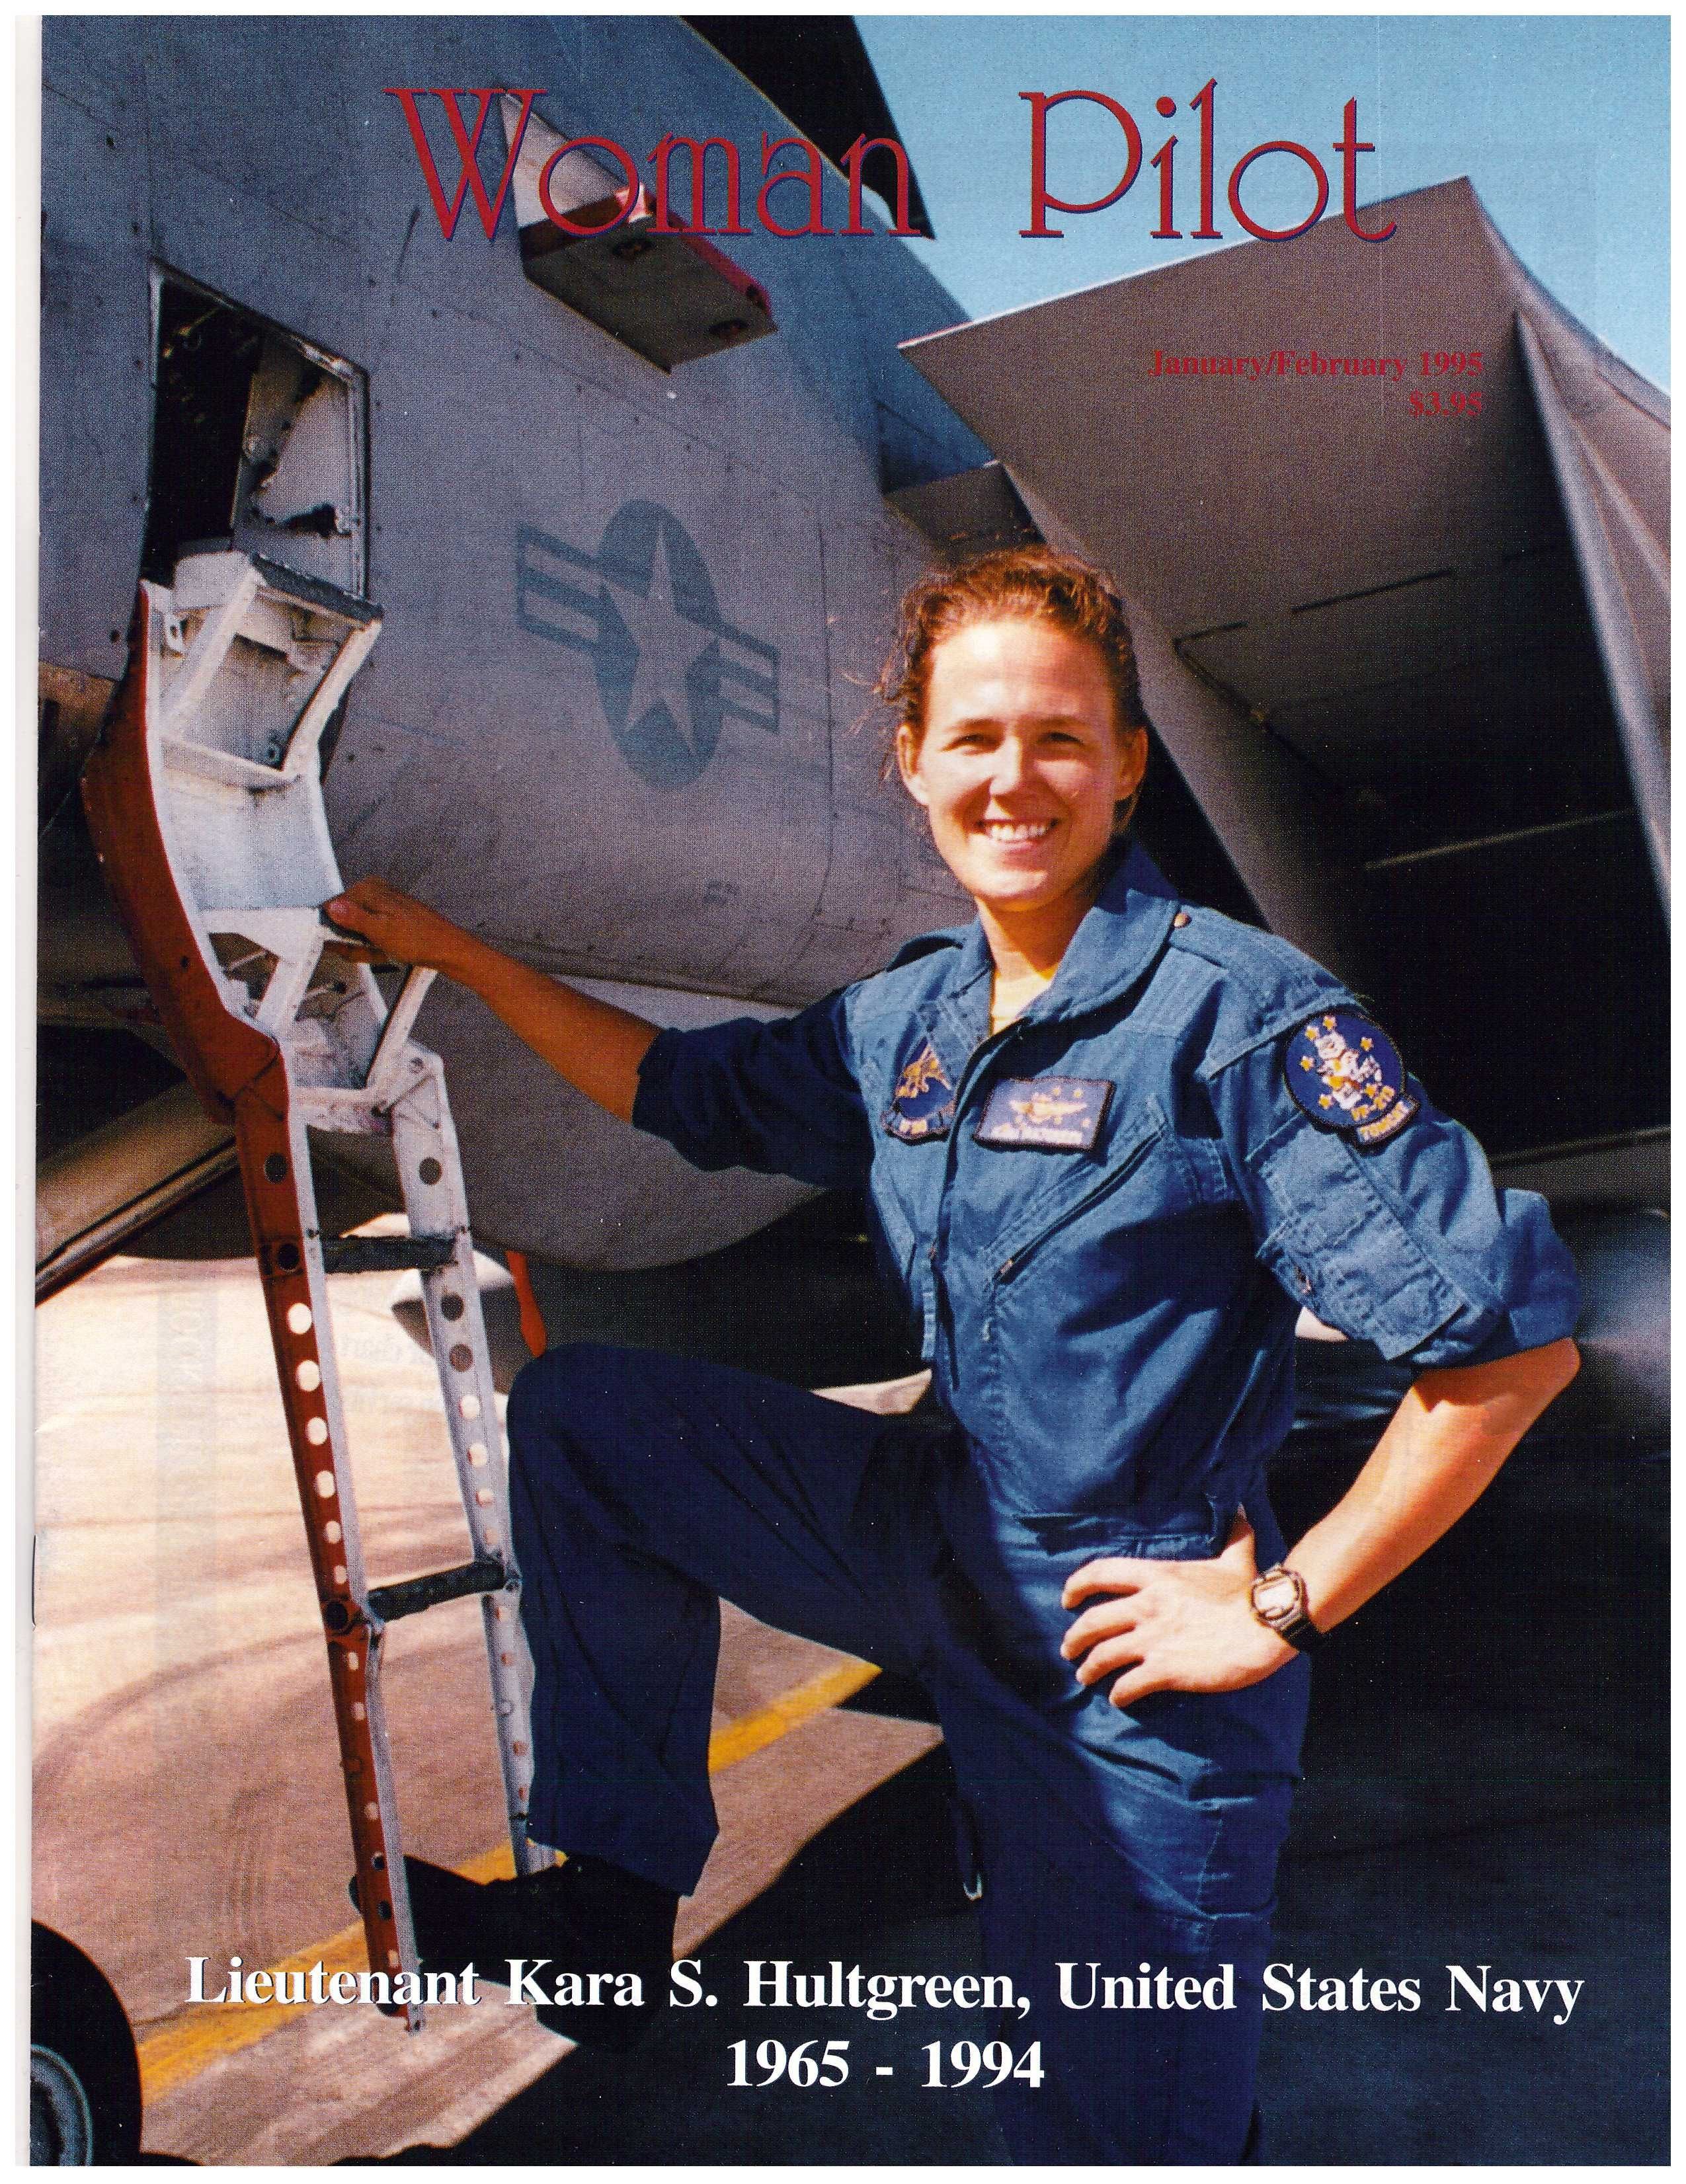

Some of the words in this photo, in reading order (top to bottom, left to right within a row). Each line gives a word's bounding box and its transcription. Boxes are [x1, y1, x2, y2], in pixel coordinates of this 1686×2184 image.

[383, 88, 923, 241] Woman
[1019, 78, 1397, 242] Pilot
[1147, 349, 1408, 381] January/February
[1419, 350, 1484, 377] 1995
[1408, 389, 1483, 418] $3.95
[184, 1957, 481, 2006] Lieutenant
[504, 1959, 645, 2006] Kara
[670, 1959, 717, 2007] S.
[743, 1961, 1030, 2021] Hultgreen,
[1055, 1962, 1237, 2011] United
[1262, 1963, 1421, 2011] States
[1445, 1965, 1585, 2025] Navy
[727, 2039, 850, 2087] 1965
[876, 2066, 893, 2076] -
[921, 2041, 1045, 2088] 1994
